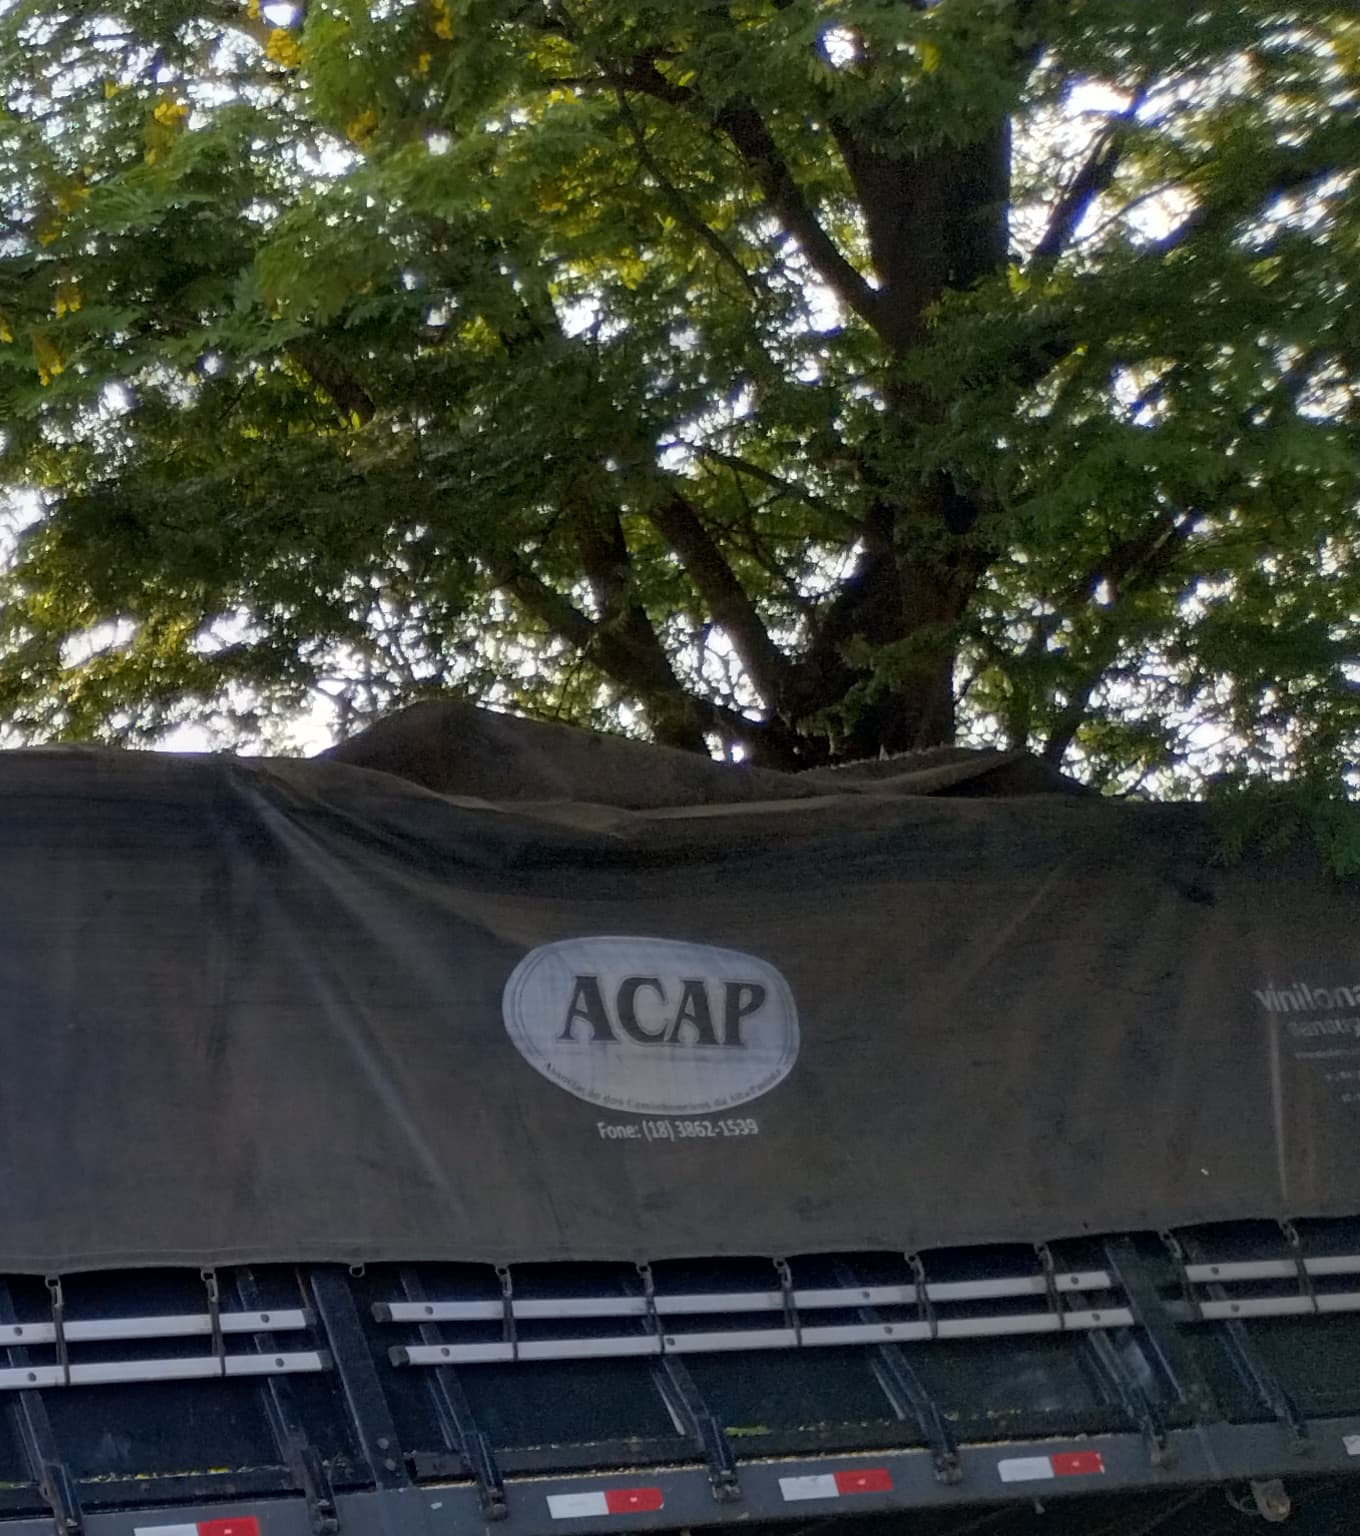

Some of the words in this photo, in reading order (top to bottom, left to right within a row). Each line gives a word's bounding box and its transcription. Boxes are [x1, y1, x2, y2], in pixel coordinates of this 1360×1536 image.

[557, 974, 767, 1050] ACAP
[597, 1121, 641, 1140] Fone:
[643, 1119, 675, 1141] (18)
